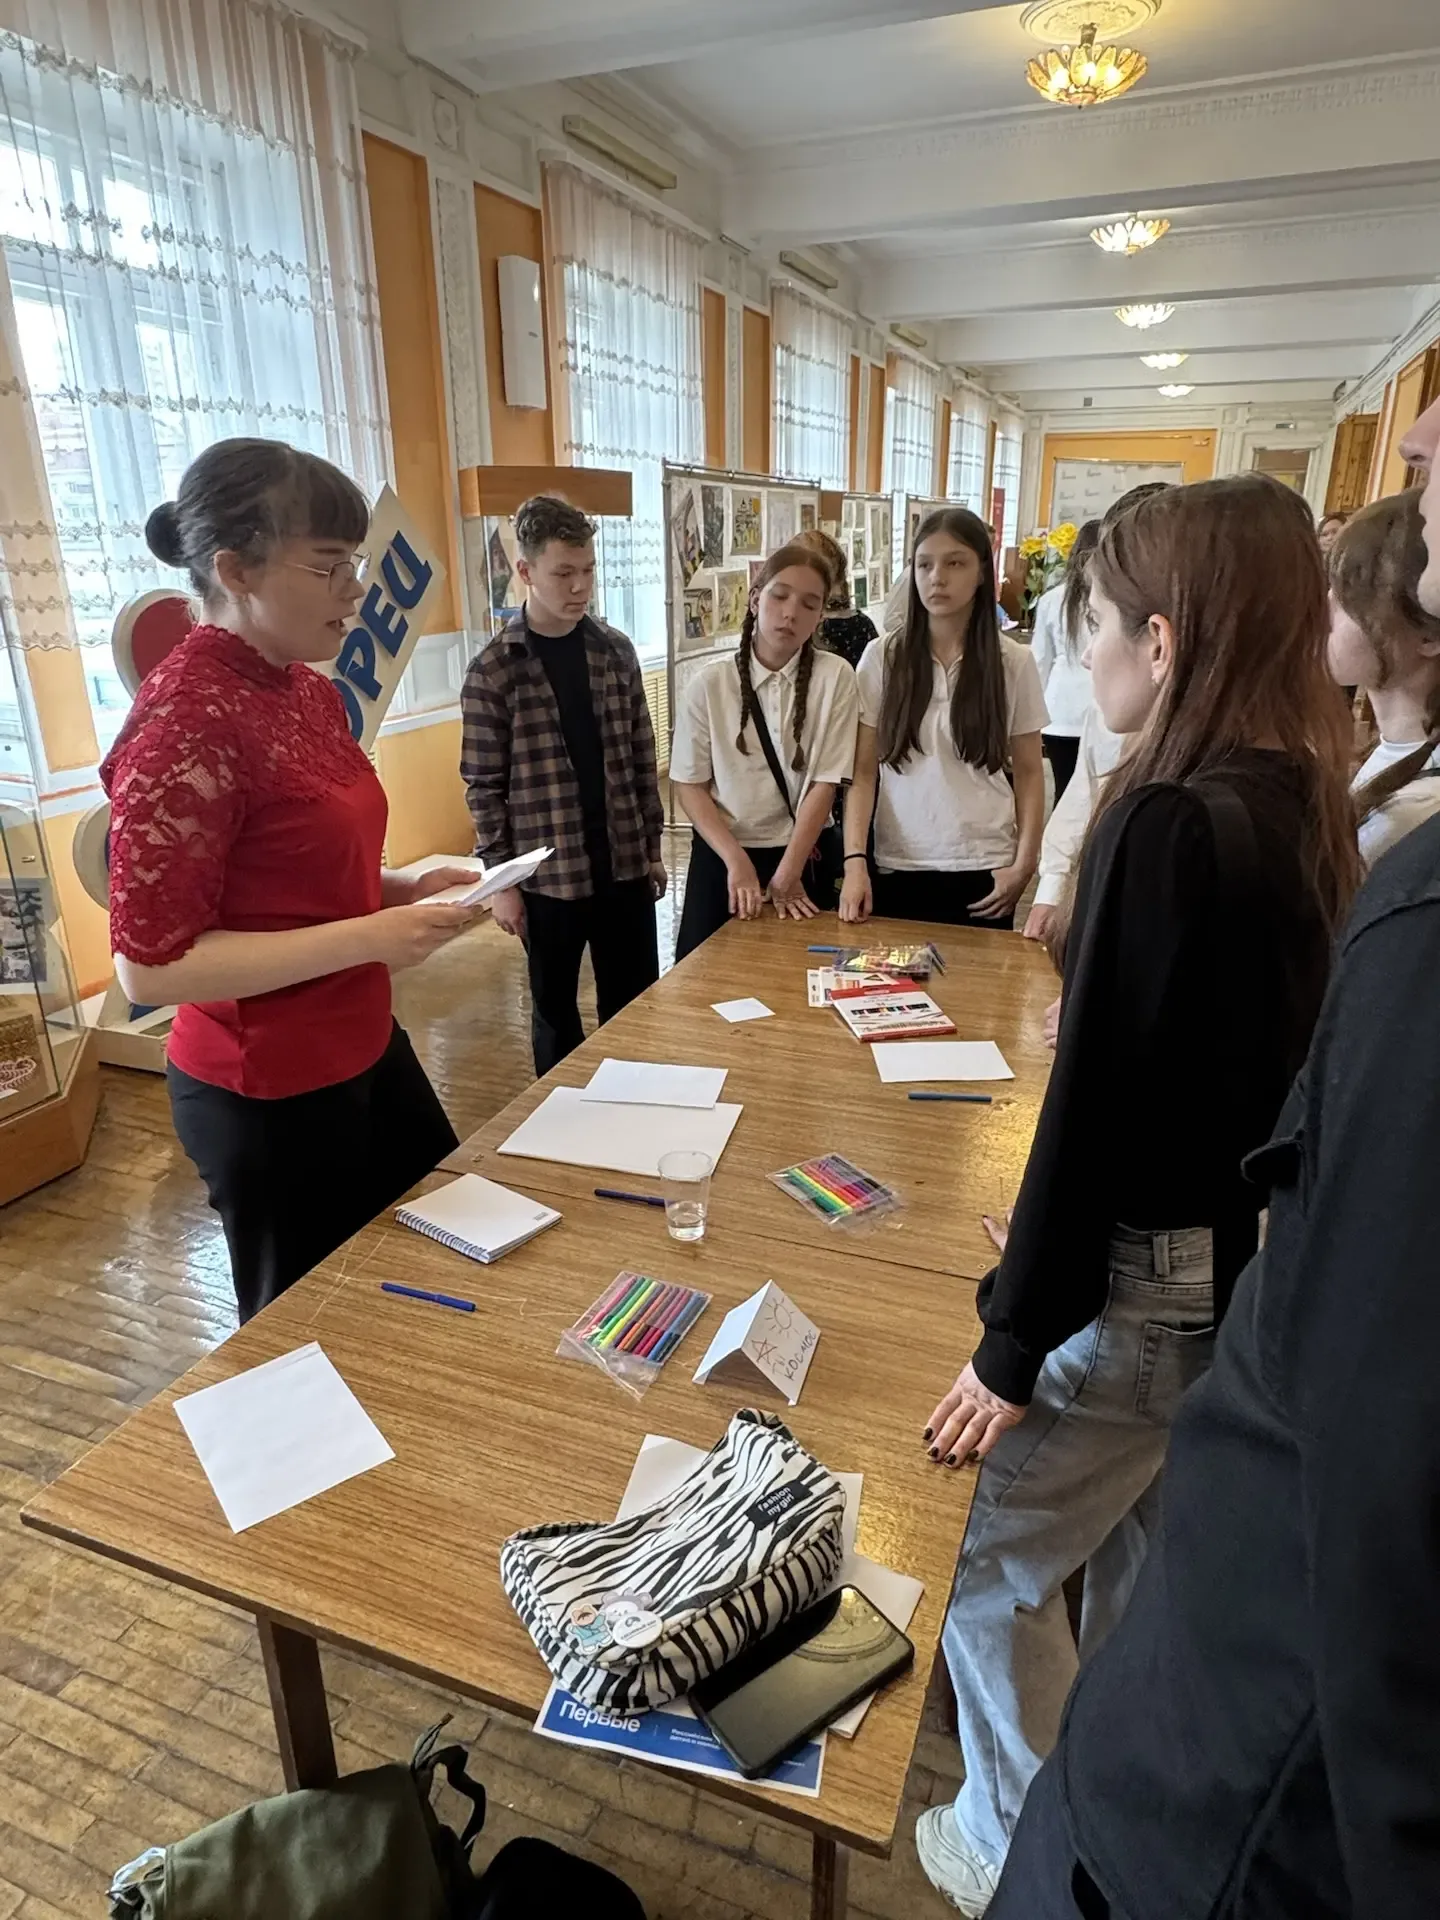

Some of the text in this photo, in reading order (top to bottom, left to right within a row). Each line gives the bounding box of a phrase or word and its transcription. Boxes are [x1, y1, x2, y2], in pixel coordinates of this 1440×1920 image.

[757, 1486, 791, 1512] fashion
[767, 1493, 795, 1516] my girl
[559, 1700, 641, 1733] Первые
